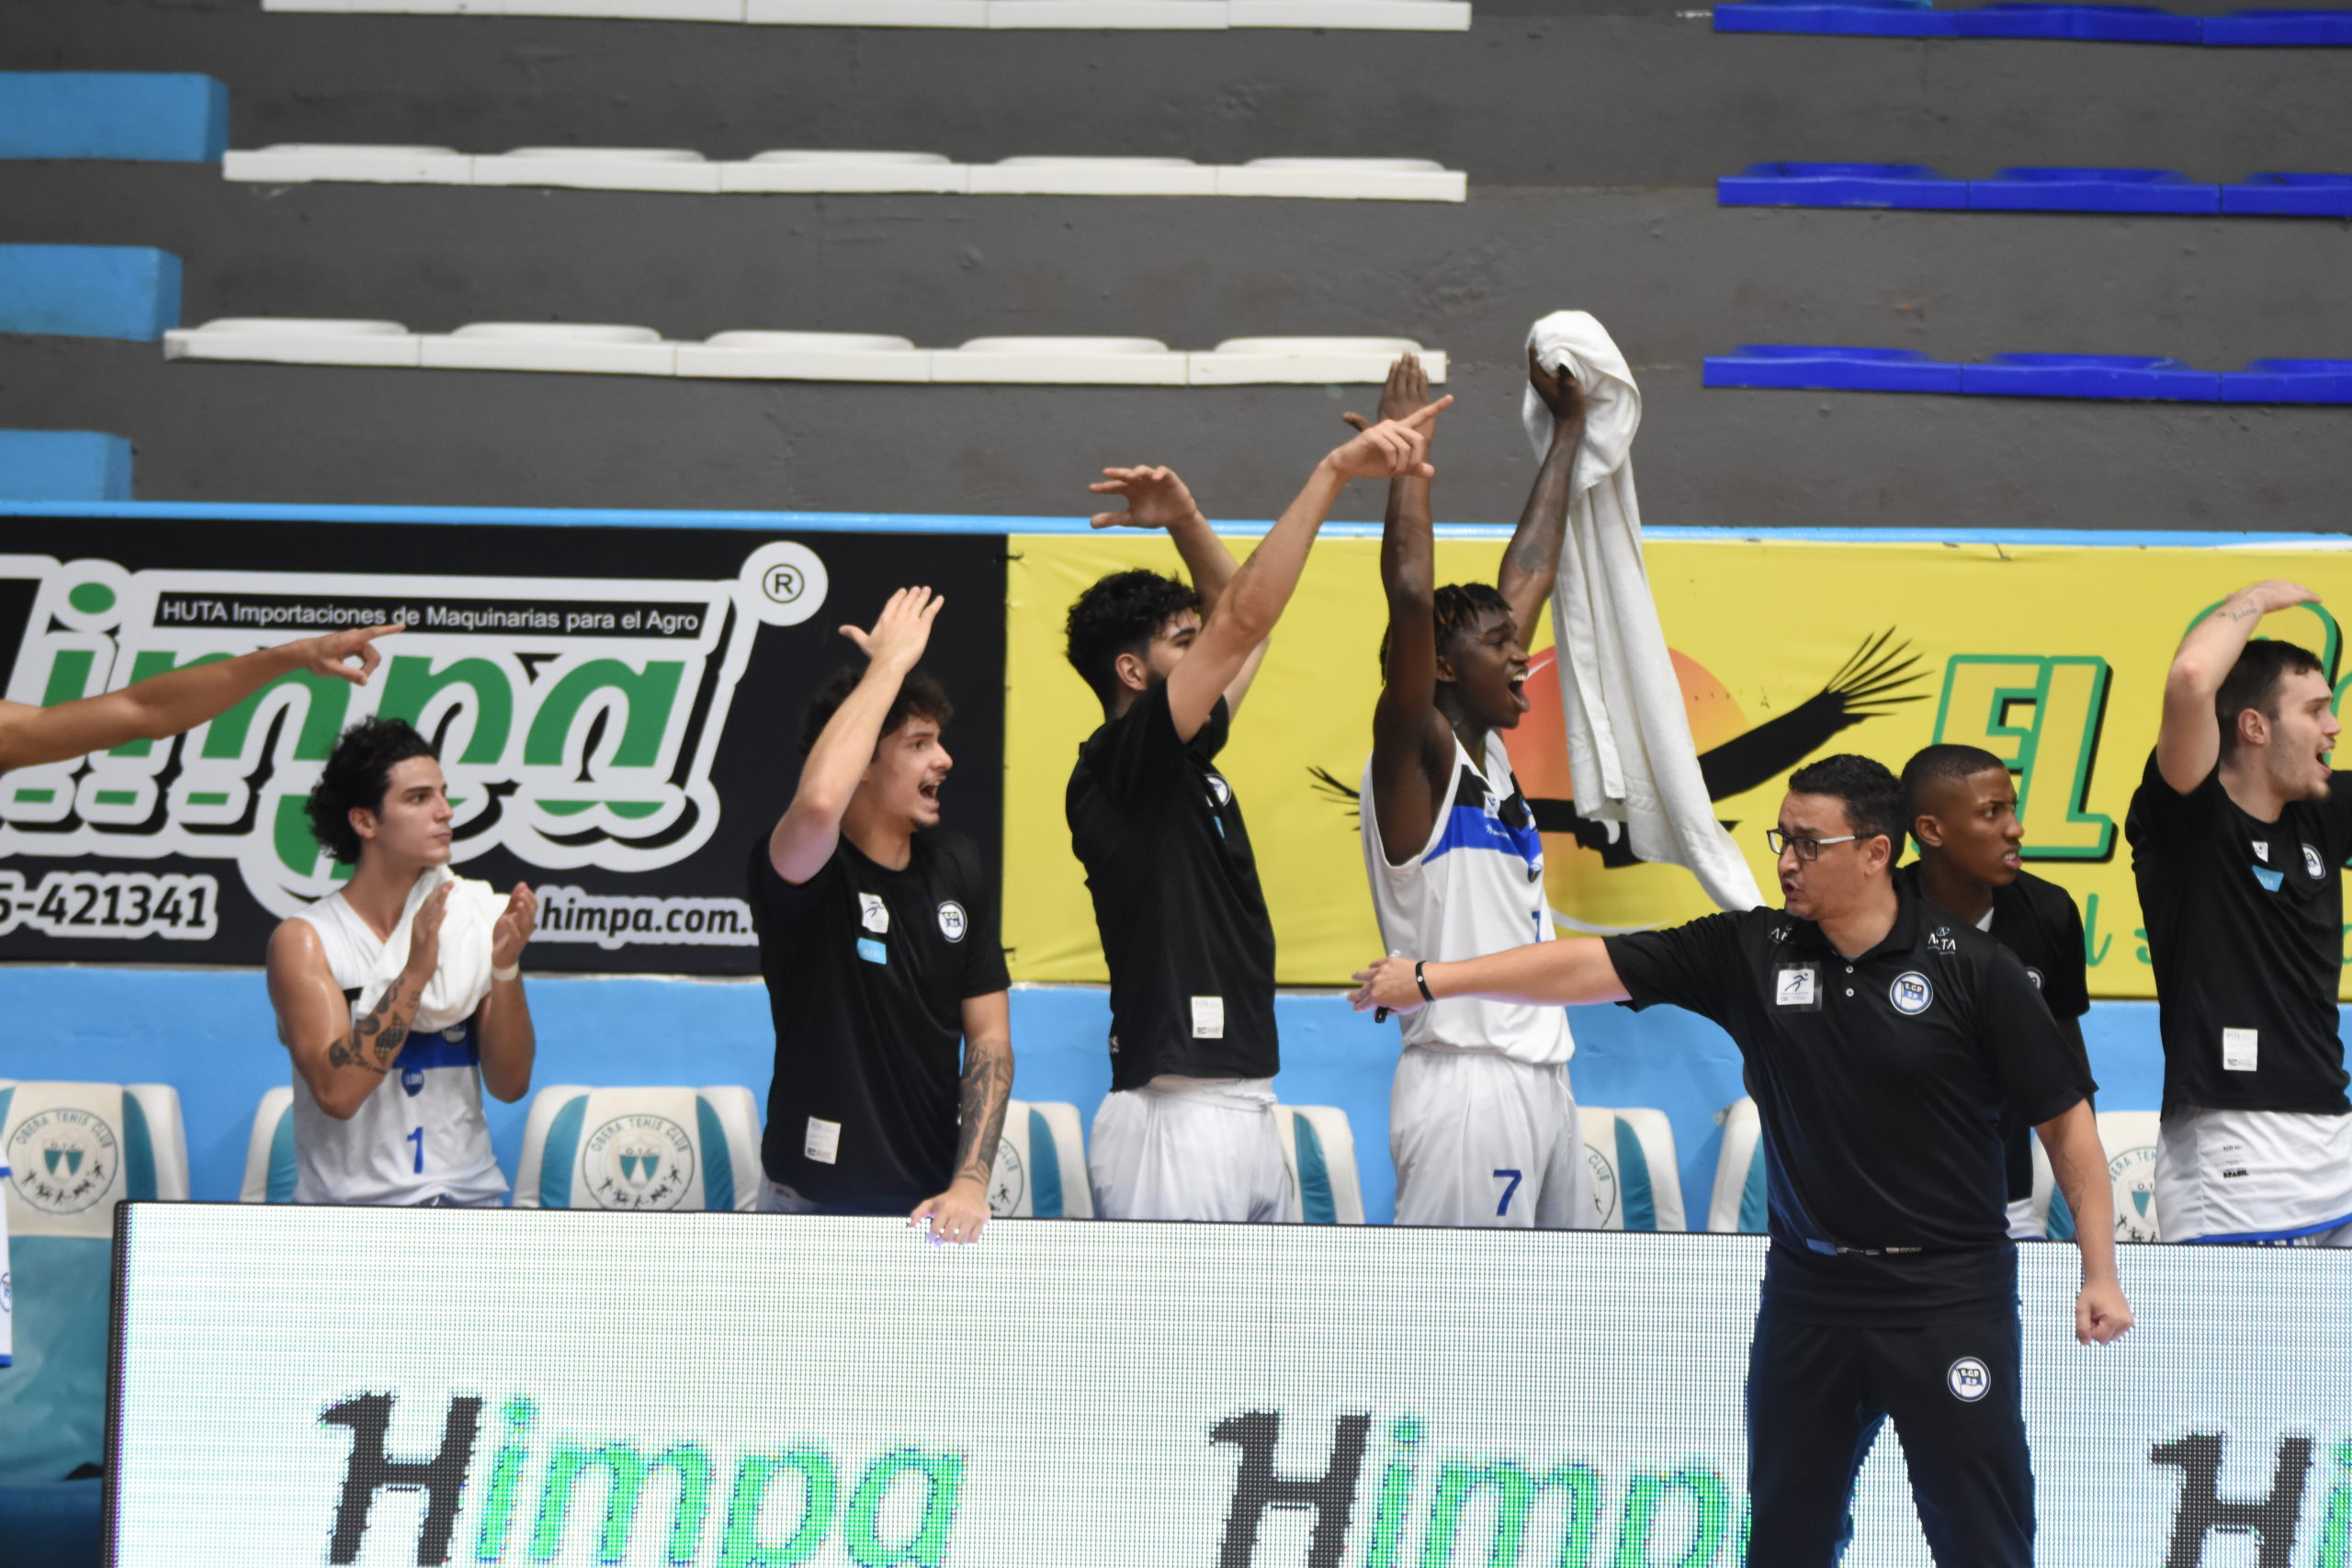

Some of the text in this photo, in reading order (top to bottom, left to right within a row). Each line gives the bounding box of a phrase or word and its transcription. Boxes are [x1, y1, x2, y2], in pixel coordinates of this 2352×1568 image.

[163, 601, 698, 634] HUTA Importaciones de Maquinarias para el Agro
[55, 1111, 90, 1126] TENIS
[92, 1122, 113, 1149] CLUB
[628, 1117, 663, 1131] TENIS
[665, 1126, 690, 1154] CLUB
[406, 1126, 424, 1175] 1
[999, 1143, 1020, 1173] CLUB
[1588, 1154, 1611, 1182] CLUB
[1493, 1169, 1522, 1216] 7
[317, 1391, 970, 1568] Himpa
[1209, 1409, 1751, 1568] Himp
